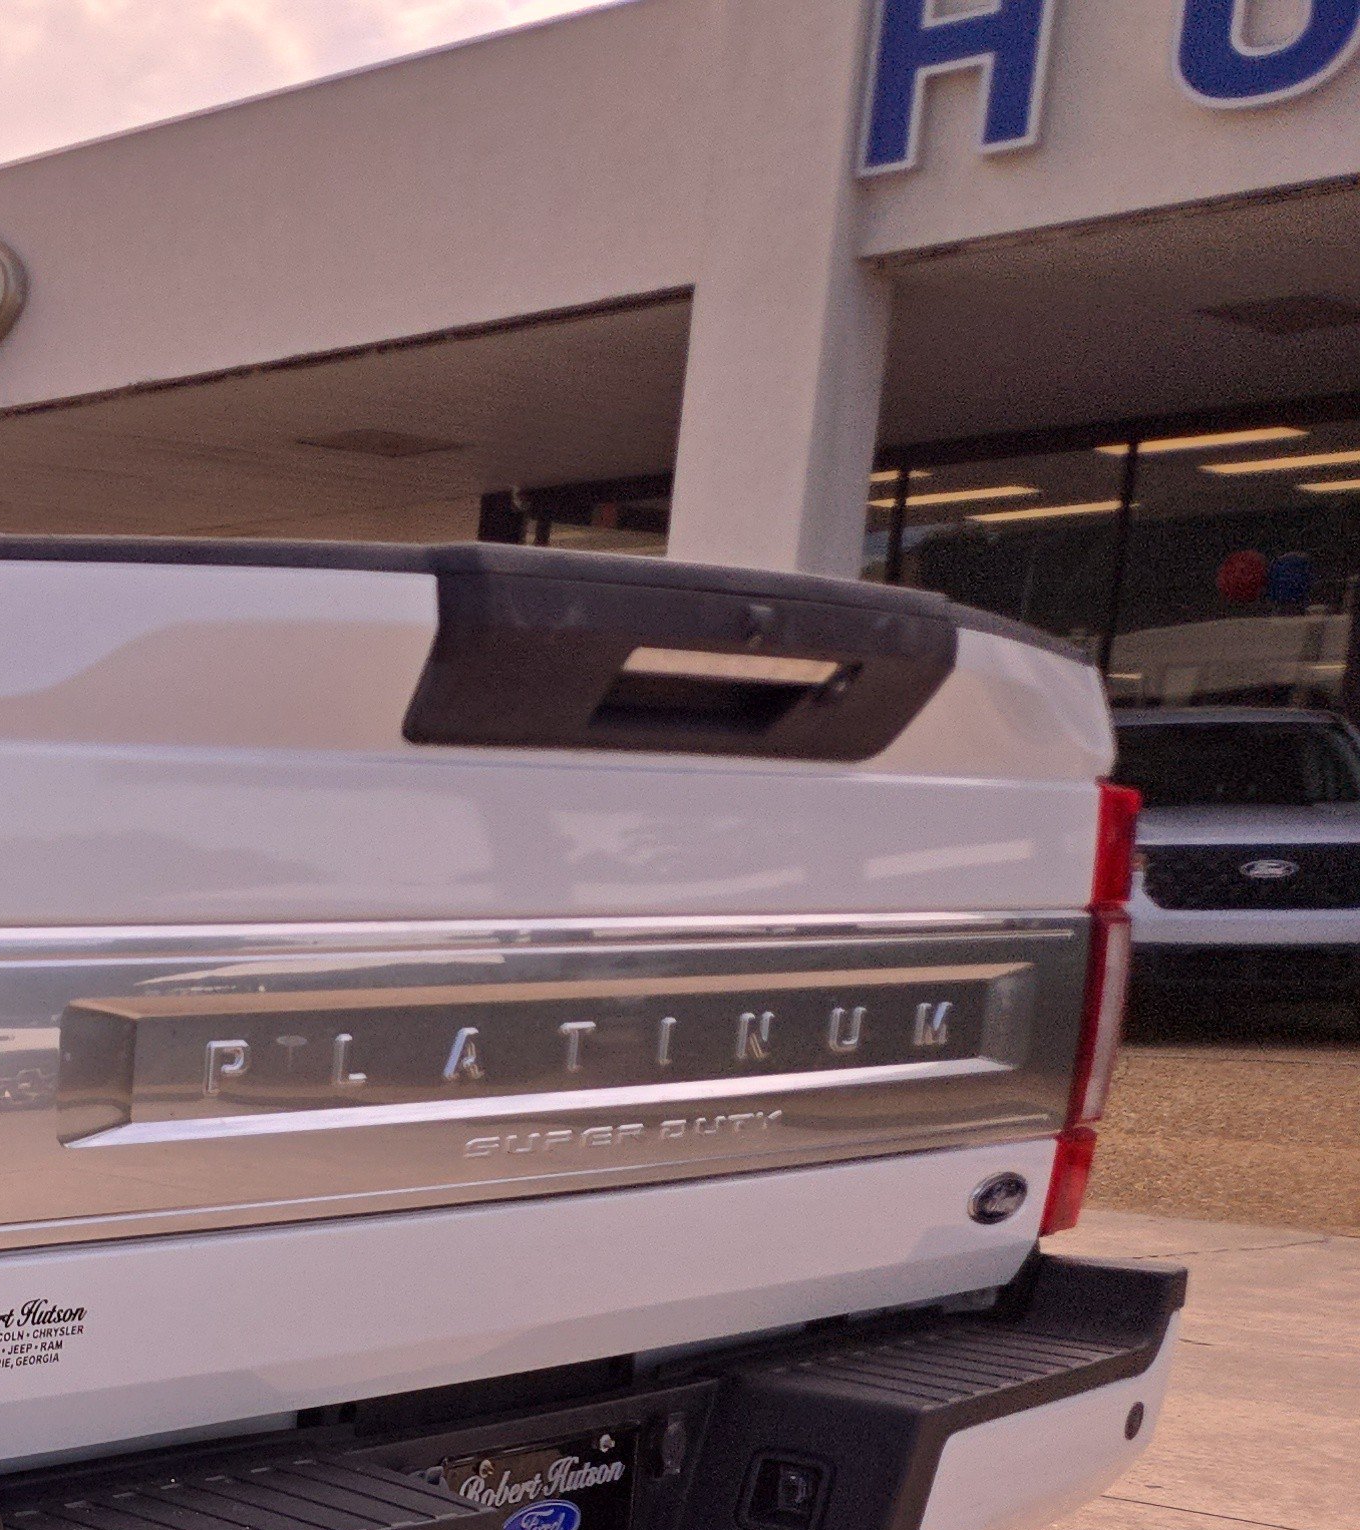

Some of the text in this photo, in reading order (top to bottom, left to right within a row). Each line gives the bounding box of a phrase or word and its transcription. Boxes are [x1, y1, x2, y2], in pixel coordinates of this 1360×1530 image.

[203, 1001, 953, 1099] PLATINUM
[463, 1109, 782, 1159] SUPER DUTY
[16, 1298, 87, 1327] Hutson
[32, 1325, 84, 1339] CHRYSLER
[7, 1343, 32, 1355] JEEP
[39, 1340, 63, 1352] RAM
[15, 1353, 59, 1367] GEORGIA
[459, 1456, 626, 1507] Robert Hutson
